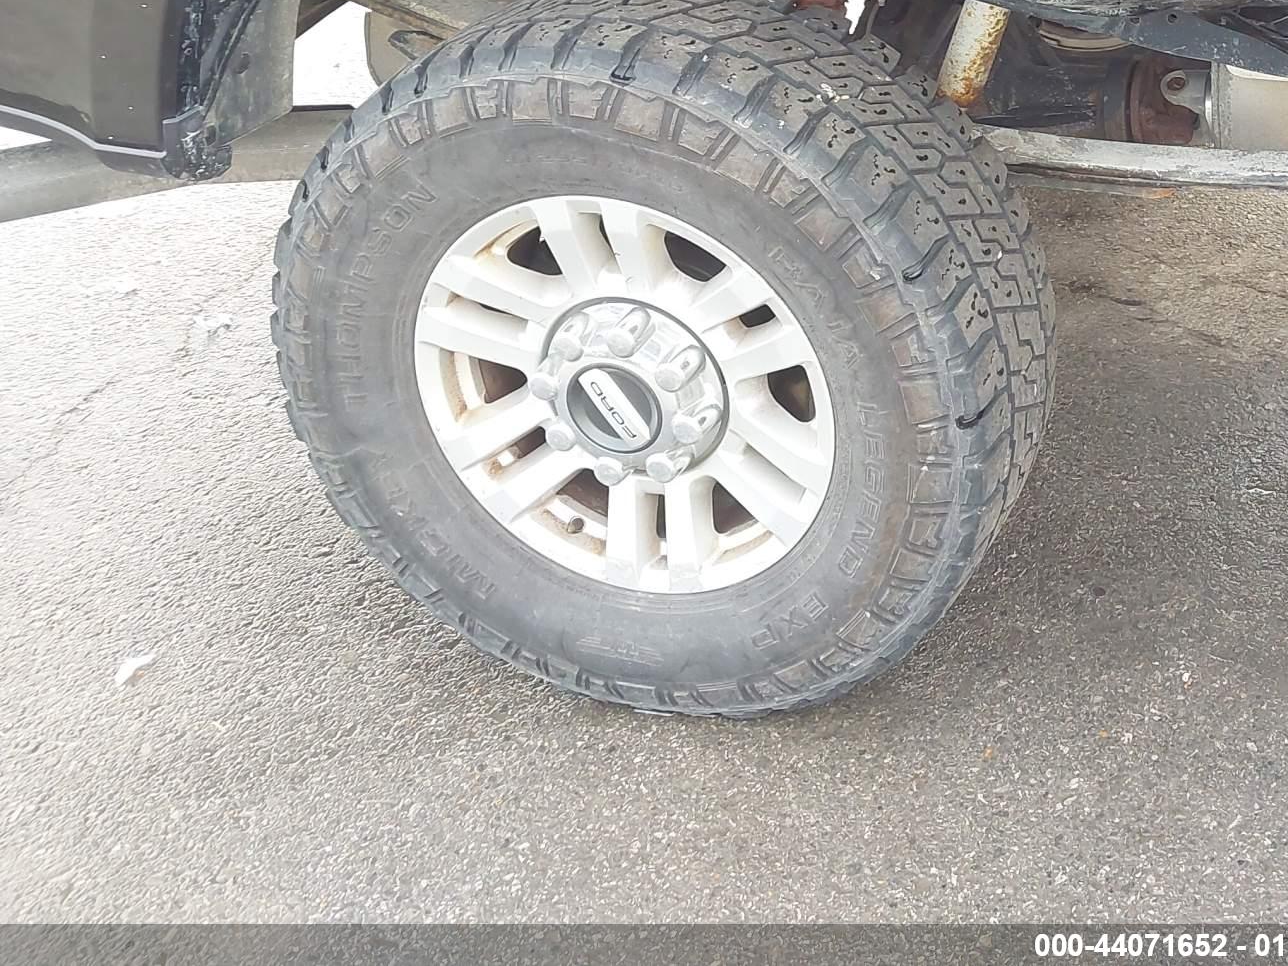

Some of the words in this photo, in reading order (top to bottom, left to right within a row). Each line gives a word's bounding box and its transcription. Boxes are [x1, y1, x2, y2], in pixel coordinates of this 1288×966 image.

[336, 179, 438, 411] THOMPSON
[590, 381, 637, 438] FORD
[838, 401, 886, 578] LEGEND
[751, 591, 829, 650] EXP
